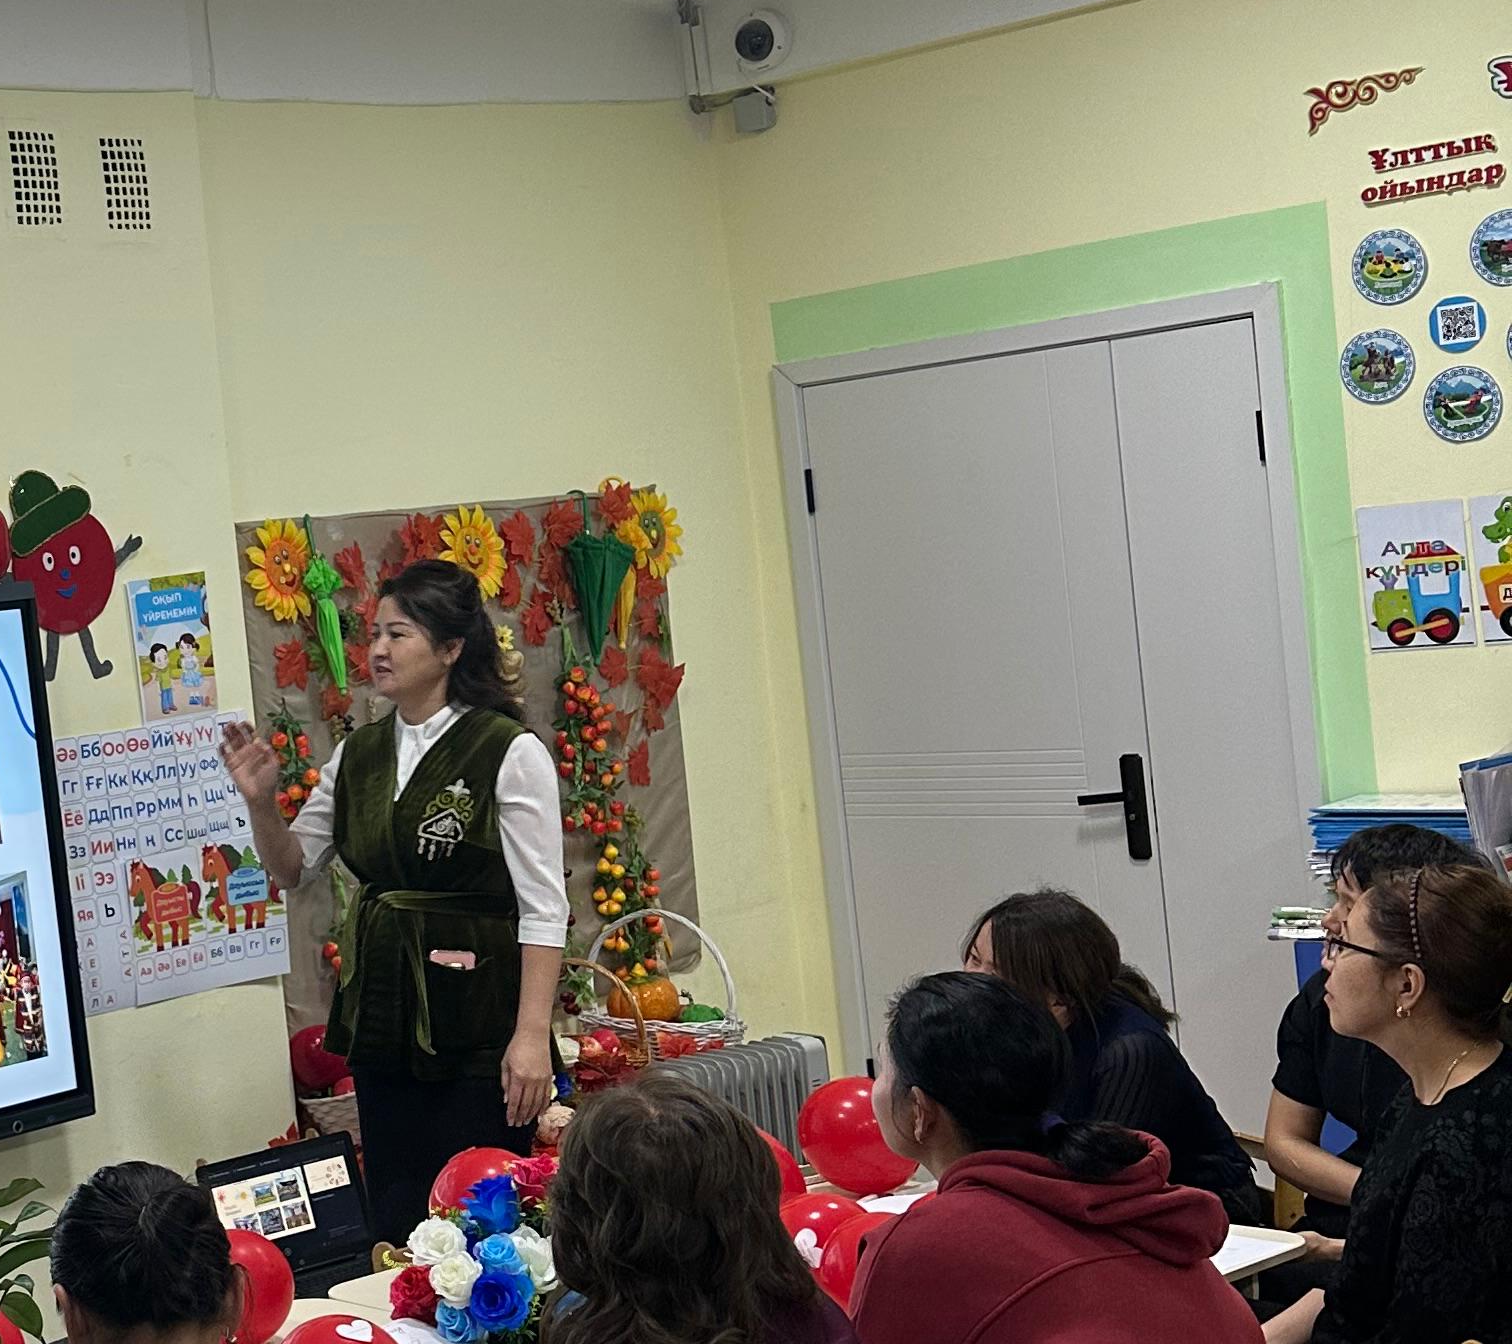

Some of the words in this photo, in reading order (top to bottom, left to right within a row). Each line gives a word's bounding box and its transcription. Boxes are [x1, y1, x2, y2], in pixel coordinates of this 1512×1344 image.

[1368, 134, 1495, 170] Ұлттық
[1361, 163, 1504, 201] ойындар
[1381, 540, 1445, 556] Апта
[1366, 559, 1466, 578] күндері
[152, 592, 182, 605] ОҚЫП
[142, 606, 198, 623] ҮЙРЕНЕМІН
[56, 748, 78, 762] Әә
[81, 741, 101, 759] Бб
[103, 742, 125, 756] Оо
[127, 738, 150, 752] Өө
[152, 730, 174, 749] Йй
[62, 780, 78, 795] Гг
[86, 776, 103, 791] Ғғ
[108, 773, 128, 789] Кк
[131, 768, 153, 785] Ққ
[155, 765, 177, 781] Лл
[180, 762, 196, 779] Уу
[199, 756, 219, 771] Фф
[64, 808, 84, 827] Ёё
[88, 808, 109, 824] Дд
[111, 806, 133, 820] Пп
[136, 801, 156, 818] Рр
[158, 796, 182, 811] Мм
[205, 789, 225, 804] Цц
[69, 845, 86, 860] Зз
[91, 840, 113, 856] Ии
[116, 837, 136, 851] Нн
[165, 828, 183, 842] Сс
[187, 827, 207, 840] Шш
[209, 820, 229, 833] Щщ
[94, 872, 114, 886] Ээ
[77, 909, 94, 922] Яя
